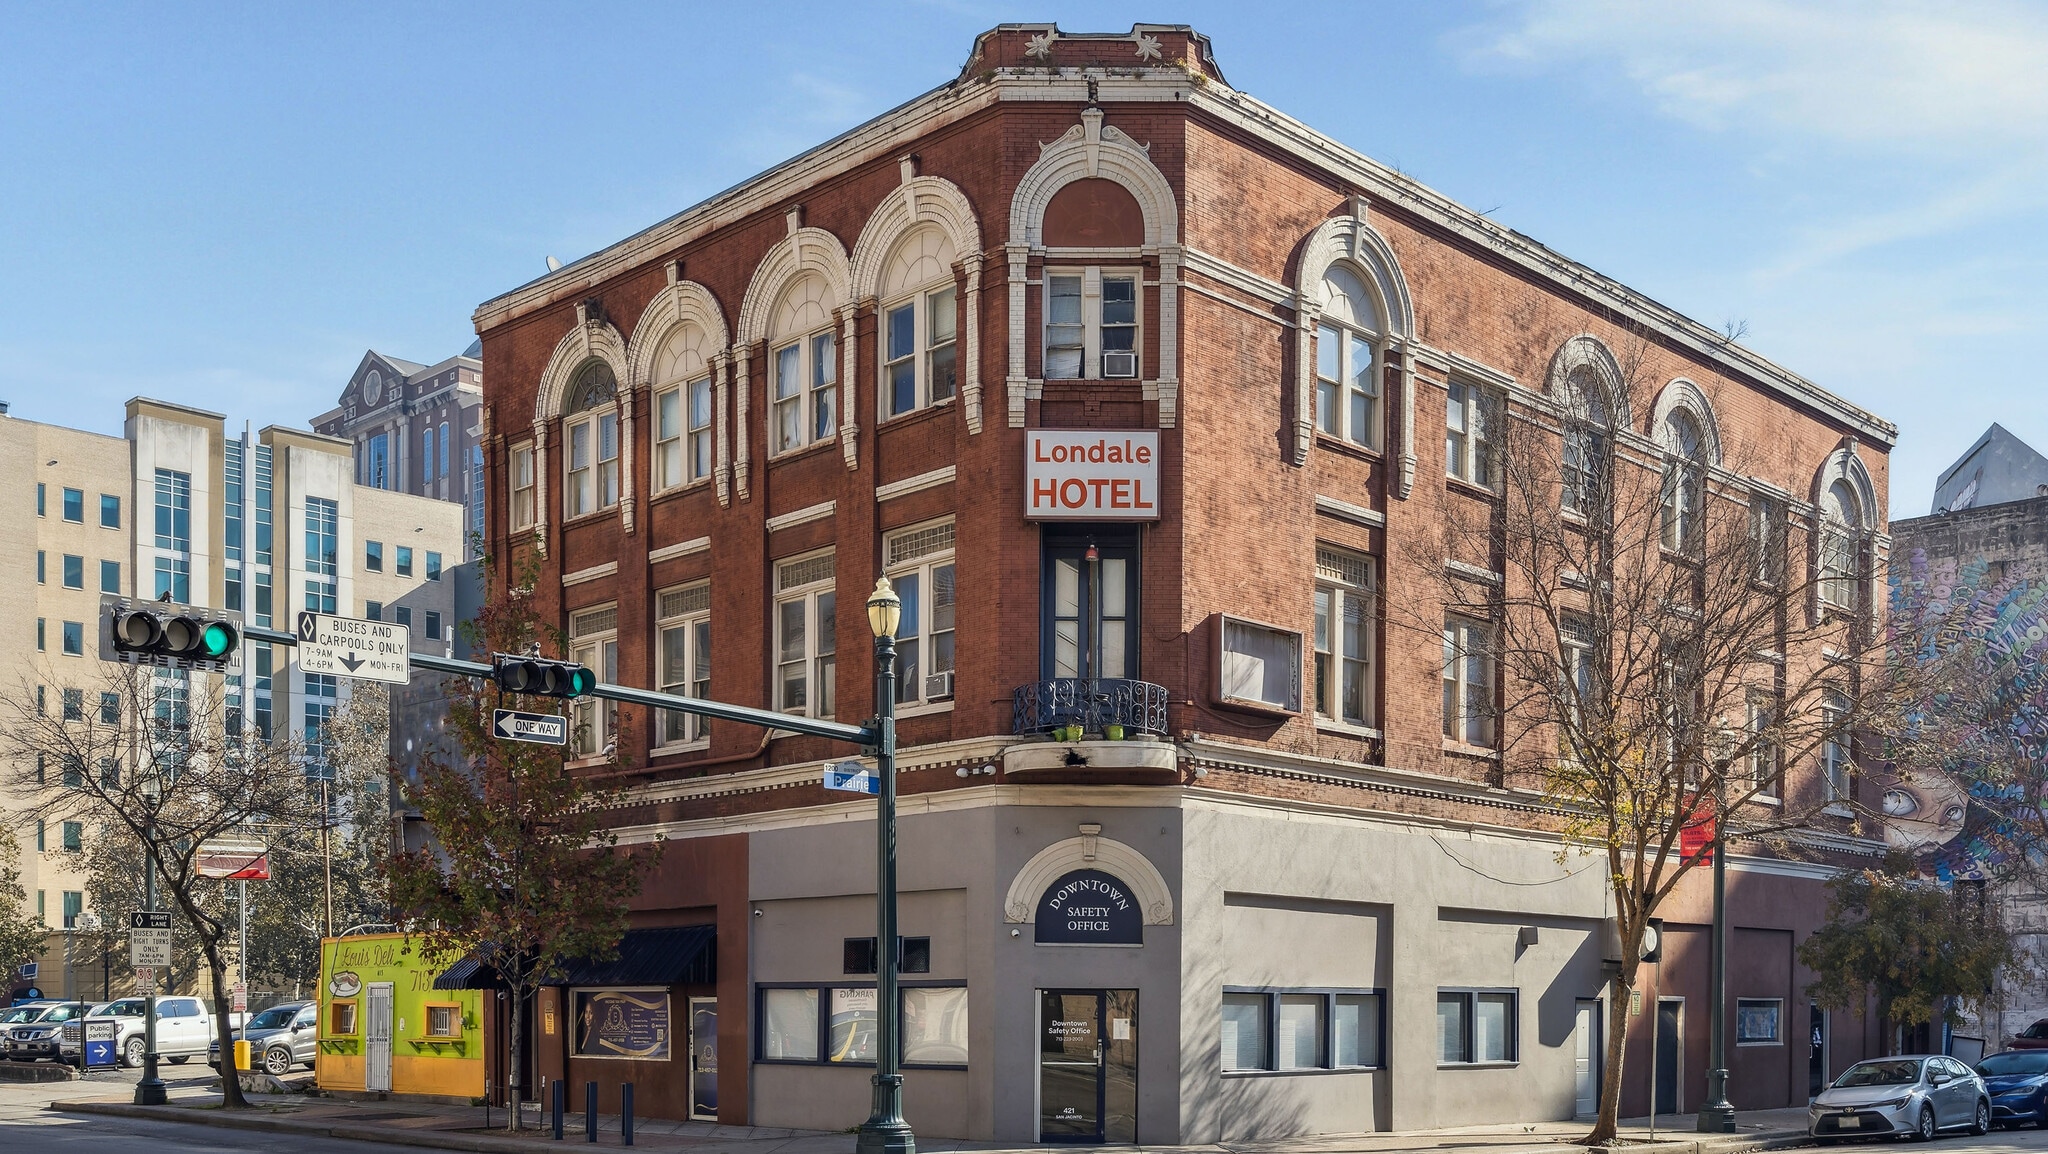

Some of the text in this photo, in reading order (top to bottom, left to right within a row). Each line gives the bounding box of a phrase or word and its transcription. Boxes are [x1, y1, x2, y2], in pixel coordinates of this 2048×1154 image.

[1035, 439, 1151, 464] Londale
[1033, 478, 1153, 509] HOTEL
[333, 621, 392, 638] BUSES AND
[320, 634, 404, 655] CARPOOLS ONLY
[306, 647, 333, 658] 7-9AM
[306, 659, 334, 669] 4-6PM
[370, 660, 404, 672] MON-FRI
[515, 721, 558, 735] ONE WAY
[836, 776, 868, 789] Prairie
[1049, 879, 1129, 911] DOWNTOWN
[1067, 906, 1110, 917] SAFETY
[1067, 921, 1110, 931] OFFICE
[374, 944, 394, 966] Deli
[1048, 1027, 1069, 1035] Safety
